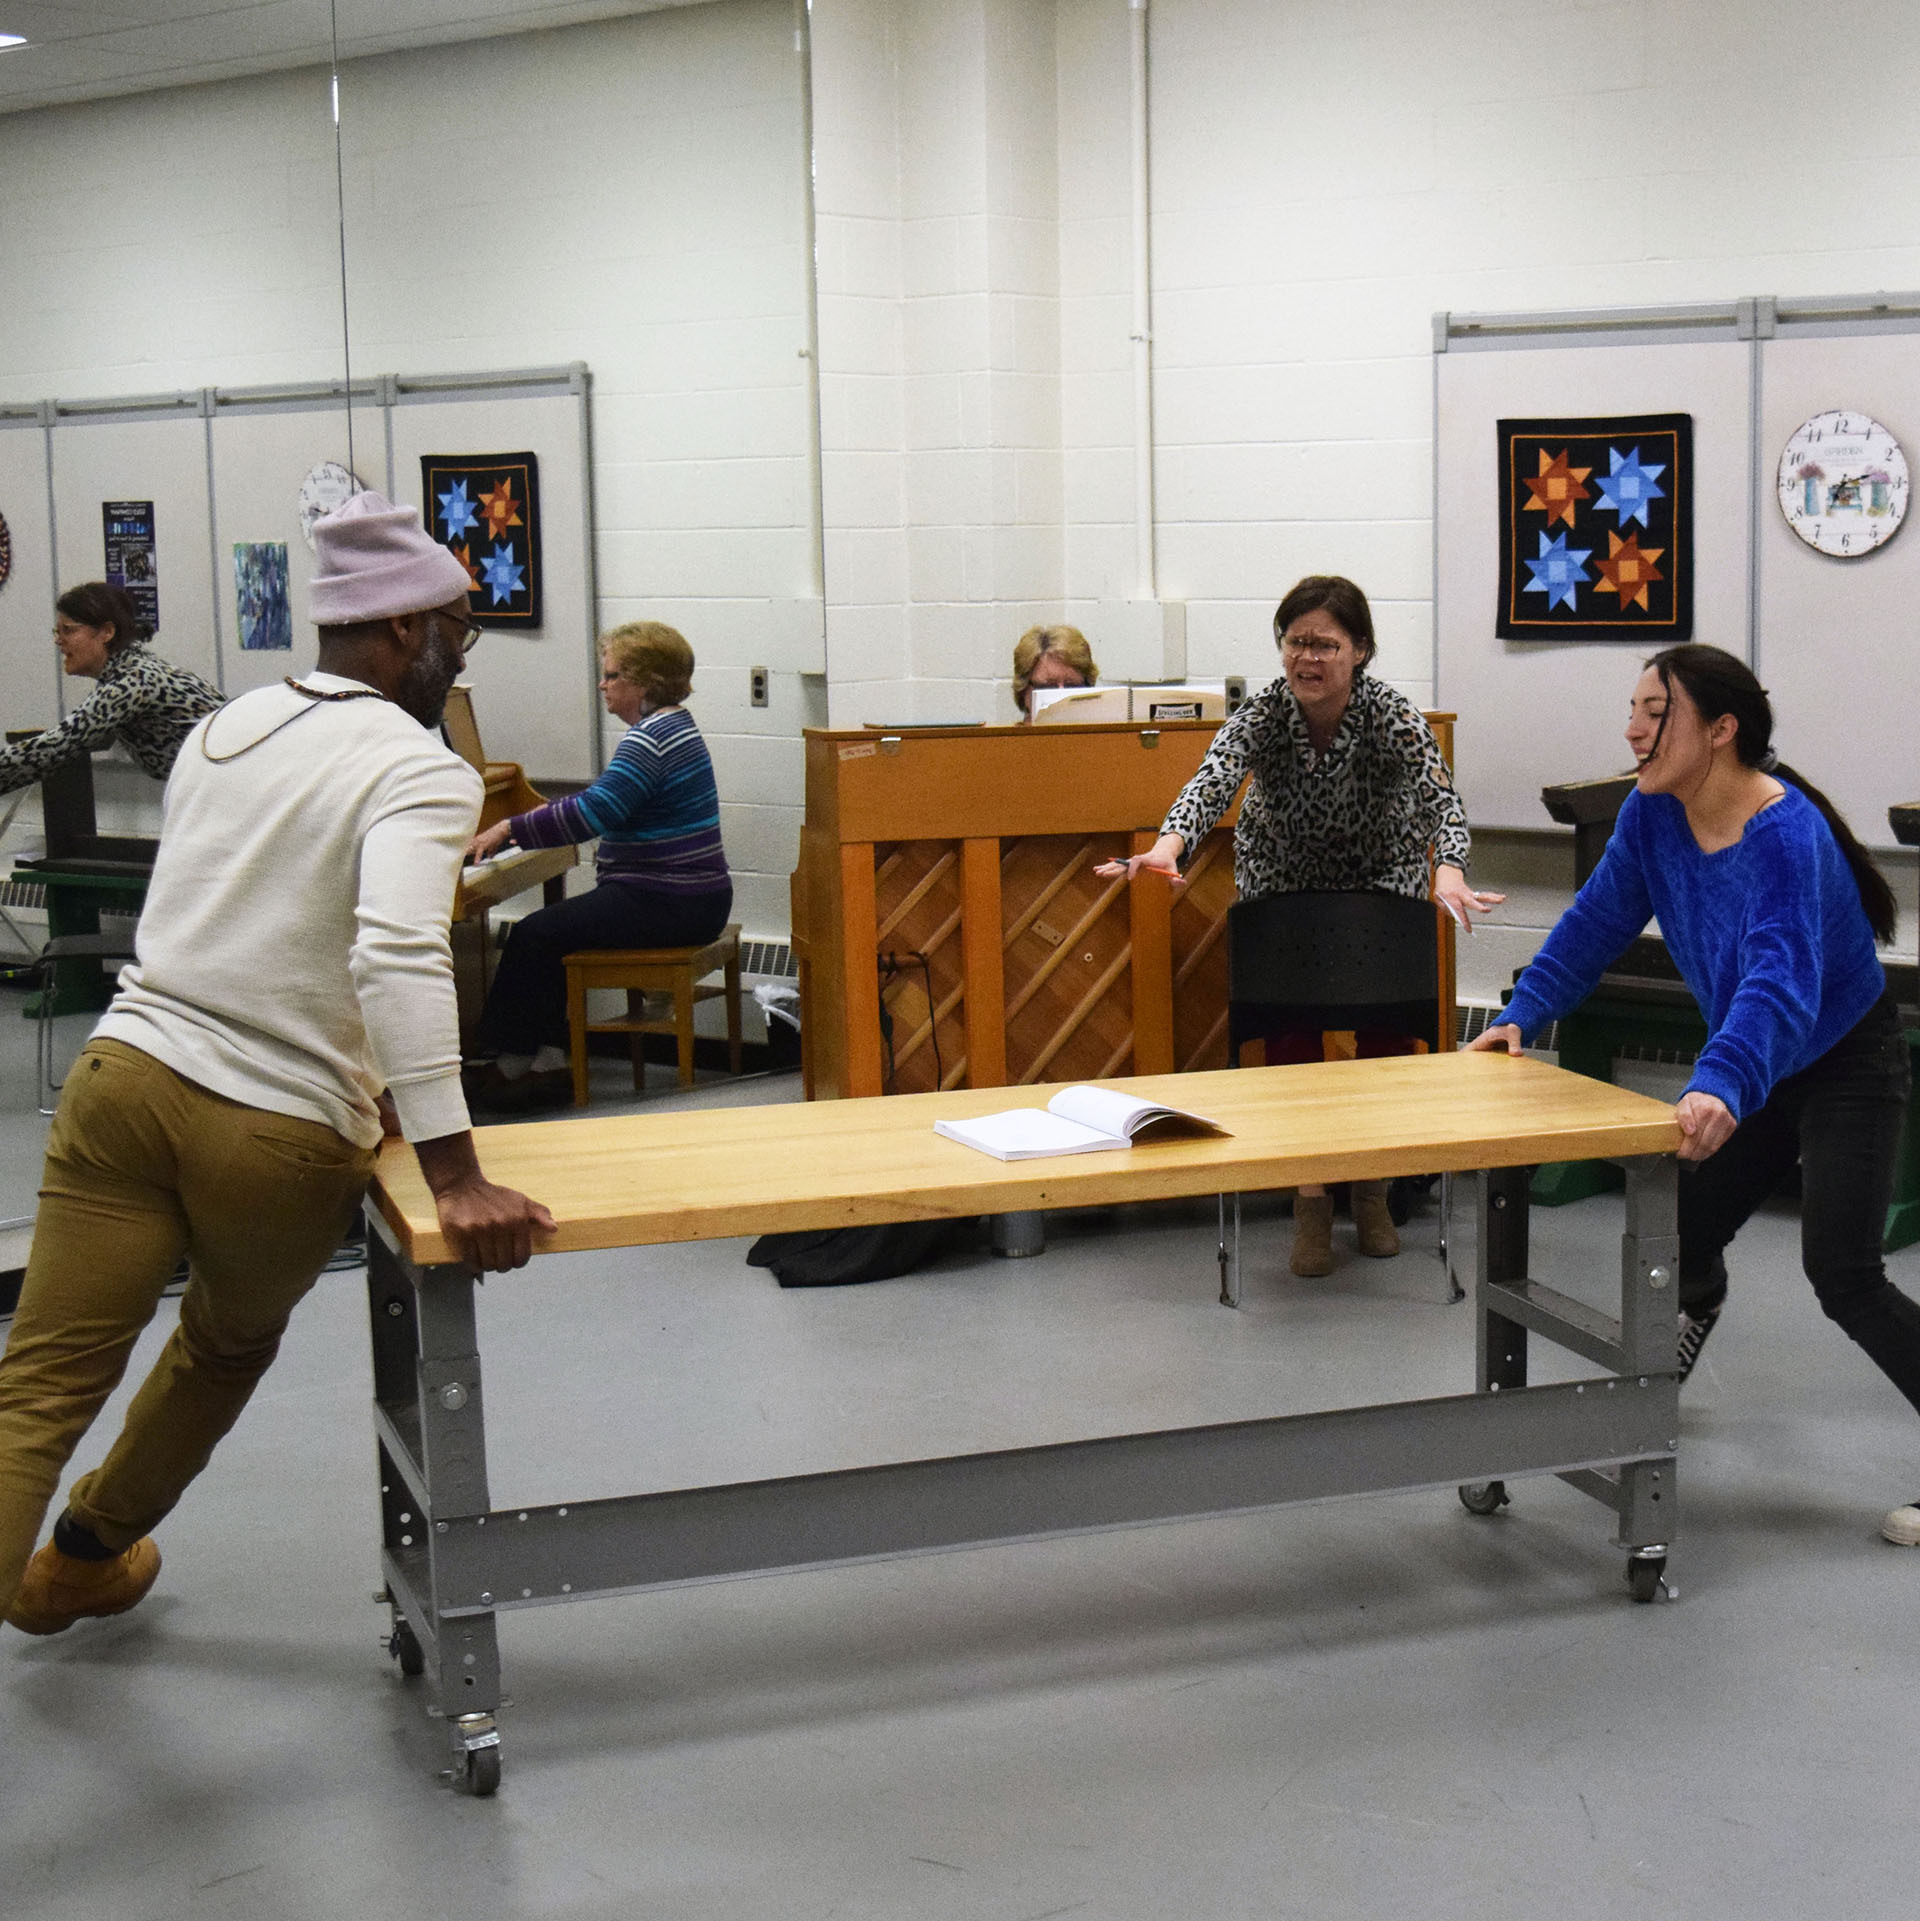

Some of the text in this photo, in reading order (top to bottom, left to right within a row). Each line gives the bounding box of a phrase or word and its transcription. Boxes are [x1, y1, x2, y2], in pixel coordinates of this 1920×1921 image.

[1834, 419, 1849, 434] 12
[1808, 429, 1822, 443] 11
[1865, 427, 1871, 441] 1
[1790, 452, 1805, 466] 10
[1885, 448, 1894, 462] 2
[1786, 479, 1796, 492] 9
[1892, 476, 1902, 489] 3
[1794, 505, 1803, 520] 8
[1888, 502, 1896, 517] 4
[1814, 524, 1822, 539] 7
[1869, 525, 1878, 538] 5
[1841, 533, 1850, 547] 6
